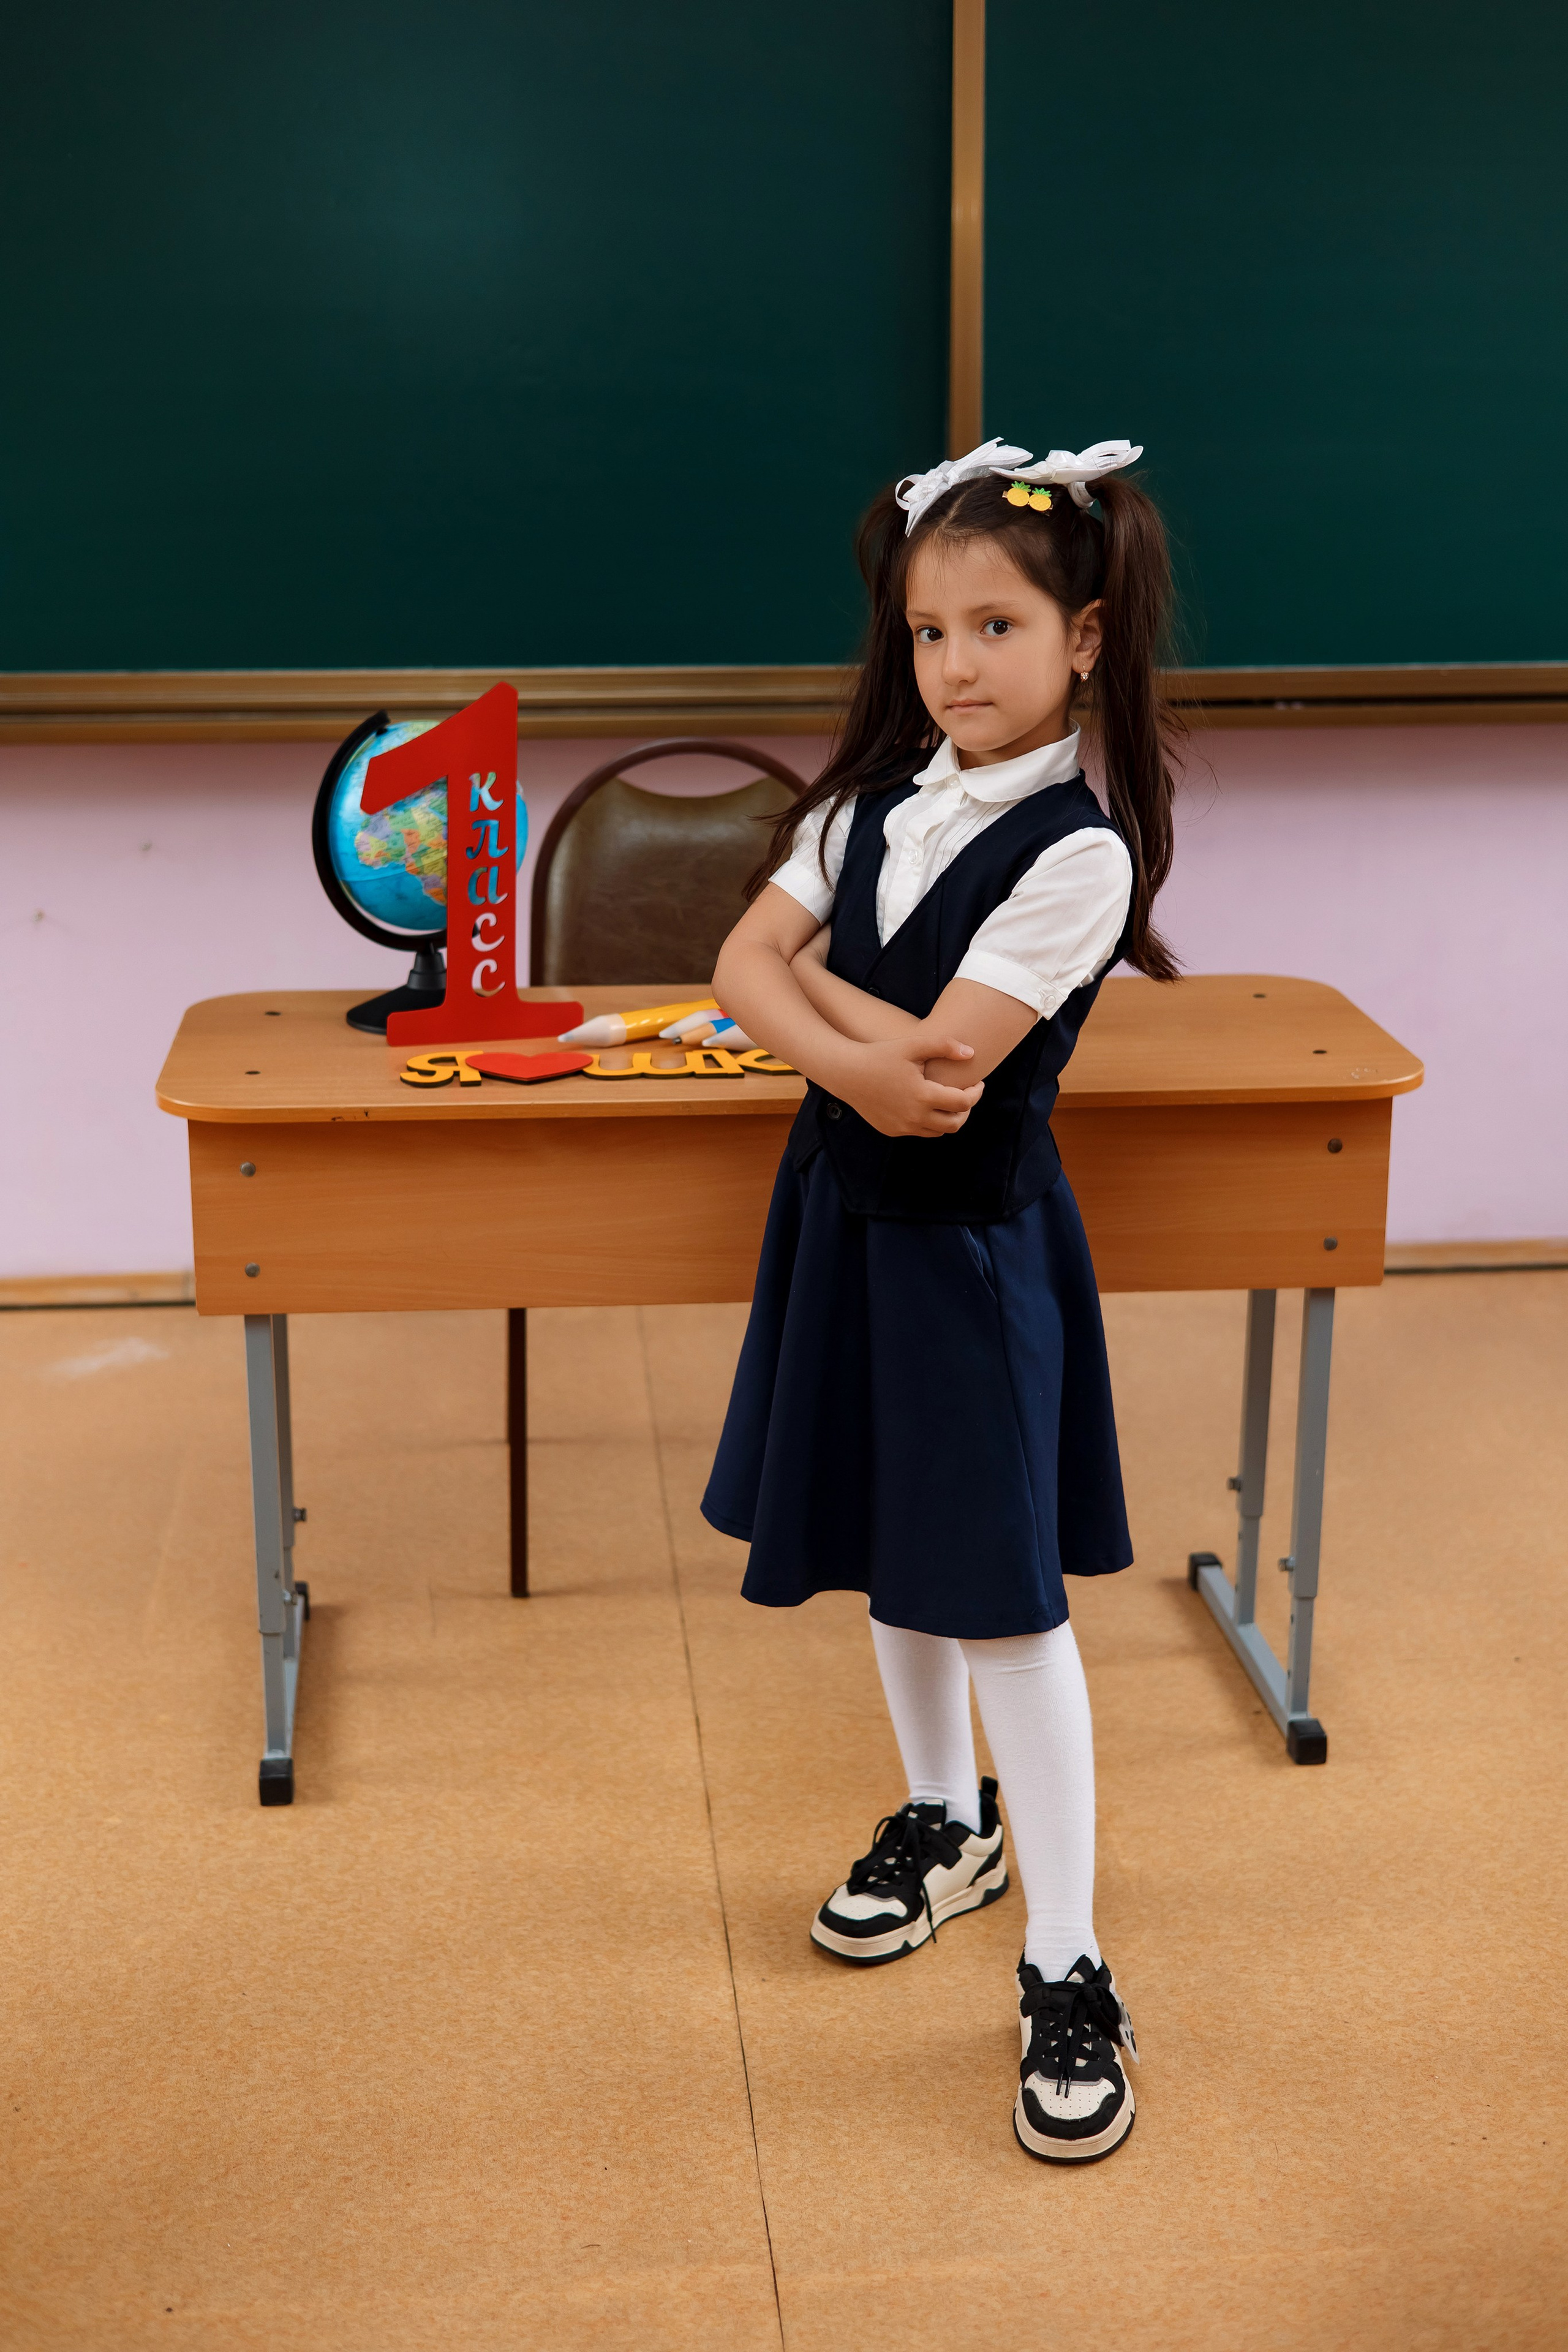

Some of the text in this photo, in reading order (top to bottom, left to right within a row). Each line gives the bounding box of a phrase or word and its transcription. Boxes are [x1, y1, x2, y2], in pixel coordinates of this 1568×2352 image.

[360, 681, 584, 1047] 1
[466, 771, 509, 998] класс
[400, 1050, 484, 1088] Я
